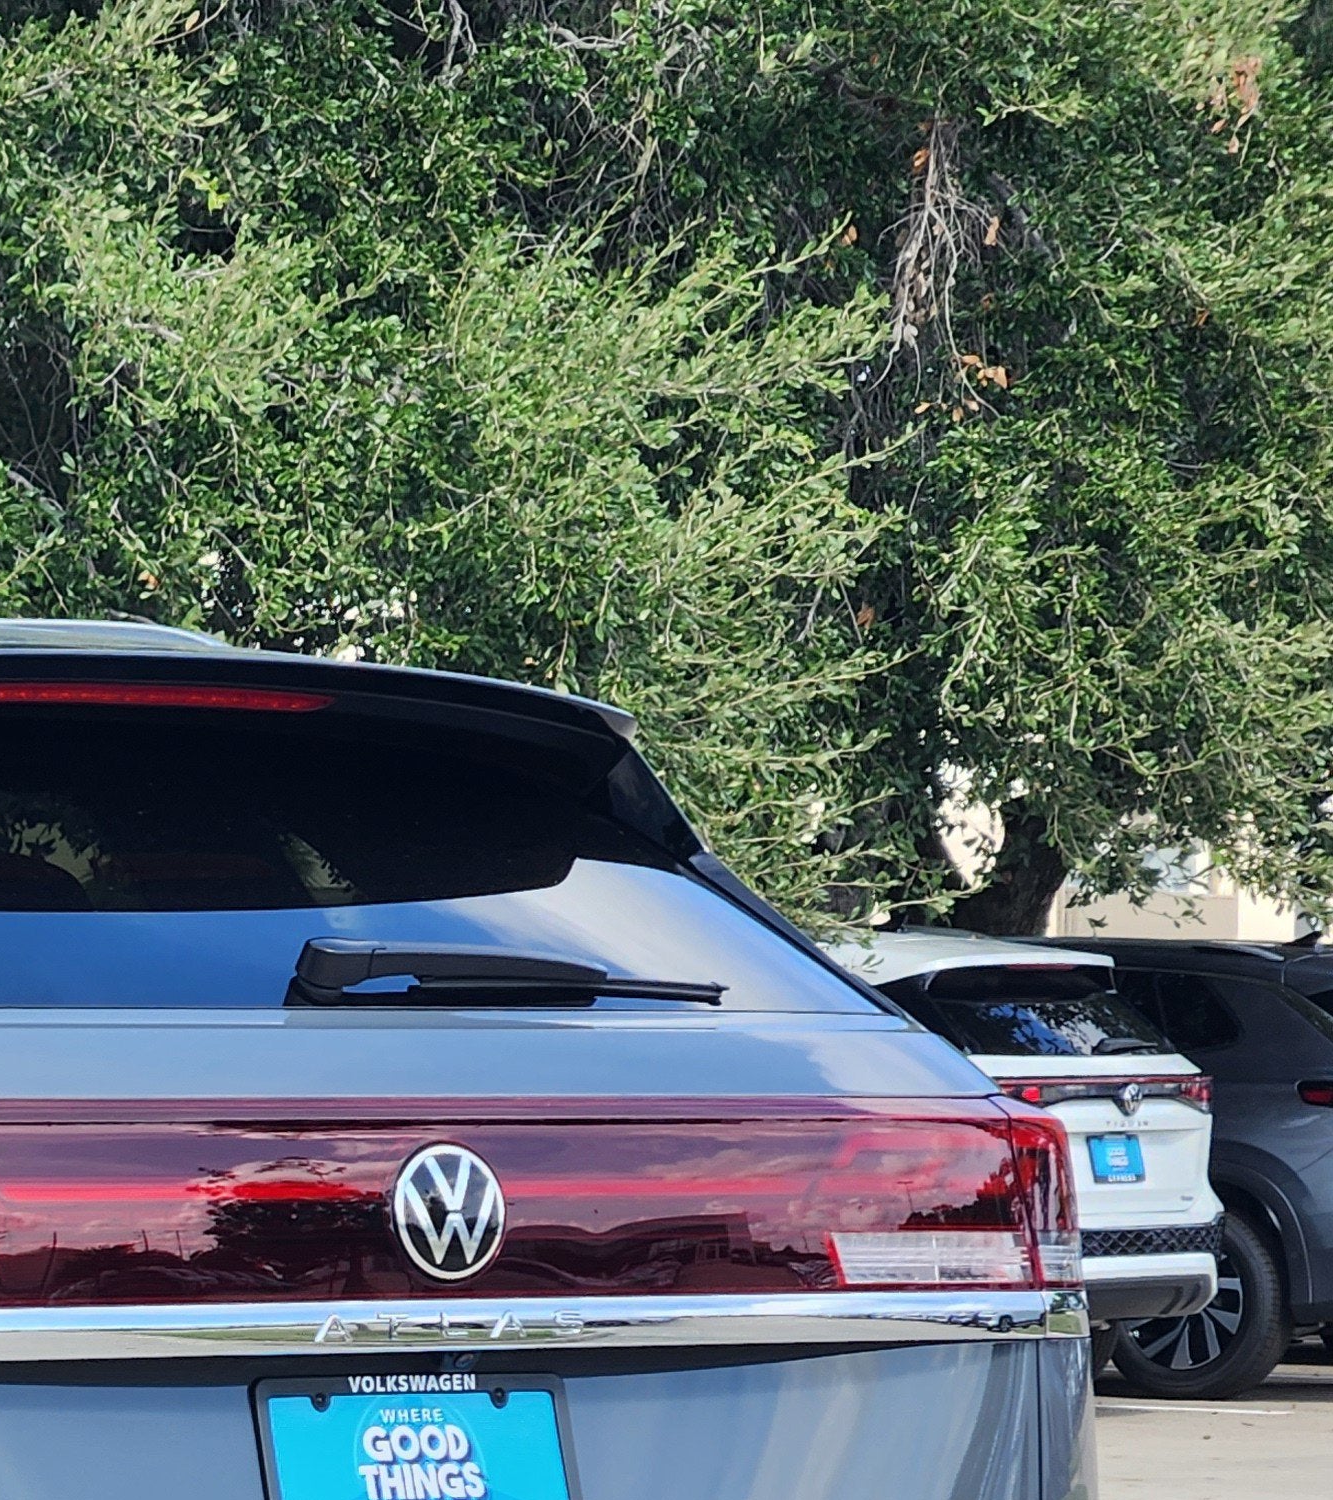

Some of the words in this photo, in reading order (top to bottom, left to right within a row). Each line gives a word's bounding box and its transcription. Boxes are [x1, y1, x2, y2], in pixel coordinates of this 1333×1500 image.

[396, 1147, 503, 1275] VW
[314, 1309, 585, 1343] ATLAS
[348, 1374, 476, 1393] VOLKSWAGEN
[380, 1409, 444, 1423] WHERE
[362, 1425, 469, 1463] GOOD
